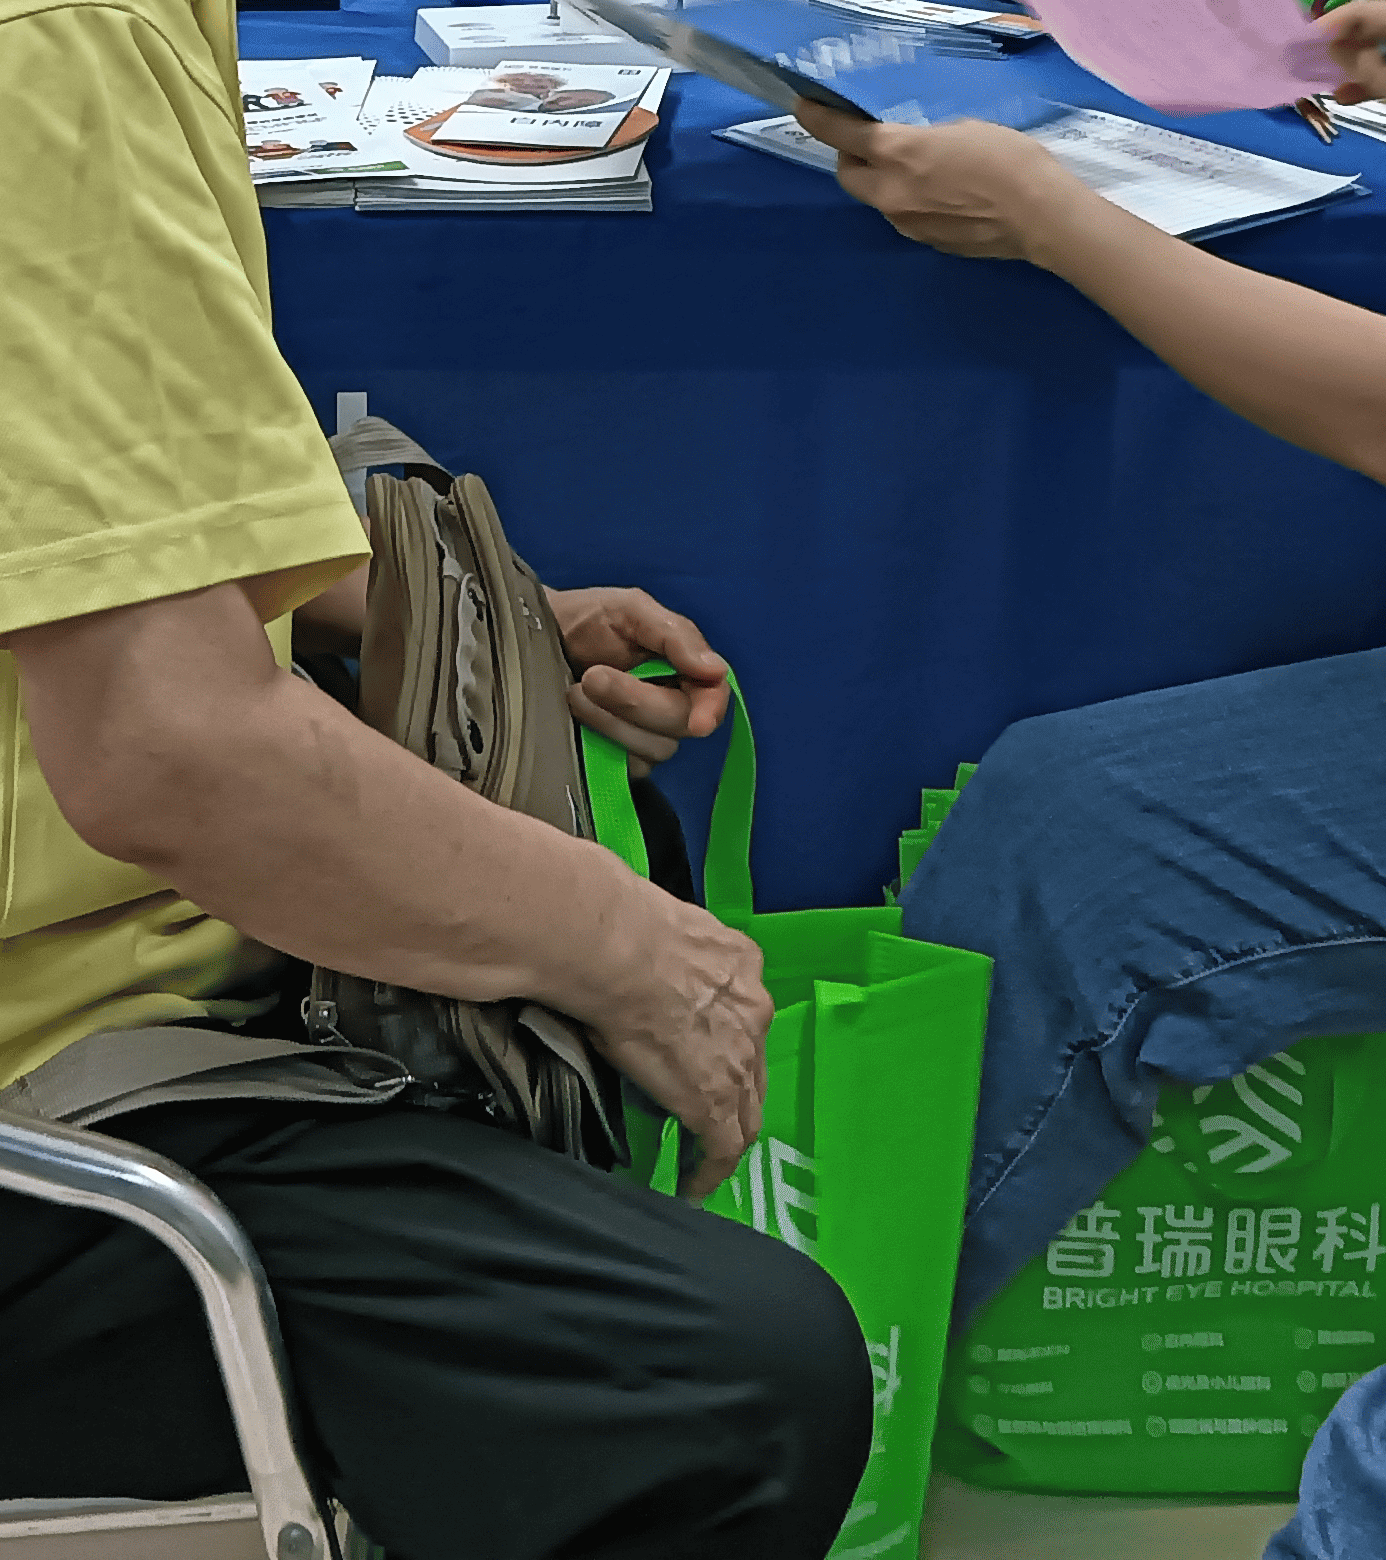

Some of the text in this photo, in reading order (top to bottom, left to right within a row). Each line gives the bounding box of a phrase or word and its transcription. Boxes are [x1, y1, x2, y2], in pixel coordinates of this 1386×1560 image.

[1046, 1201, 1386, 1278] 普瑞眼科
[1043, 1280, 1377, 1309] BRIGHT EYE HOSPITAL
